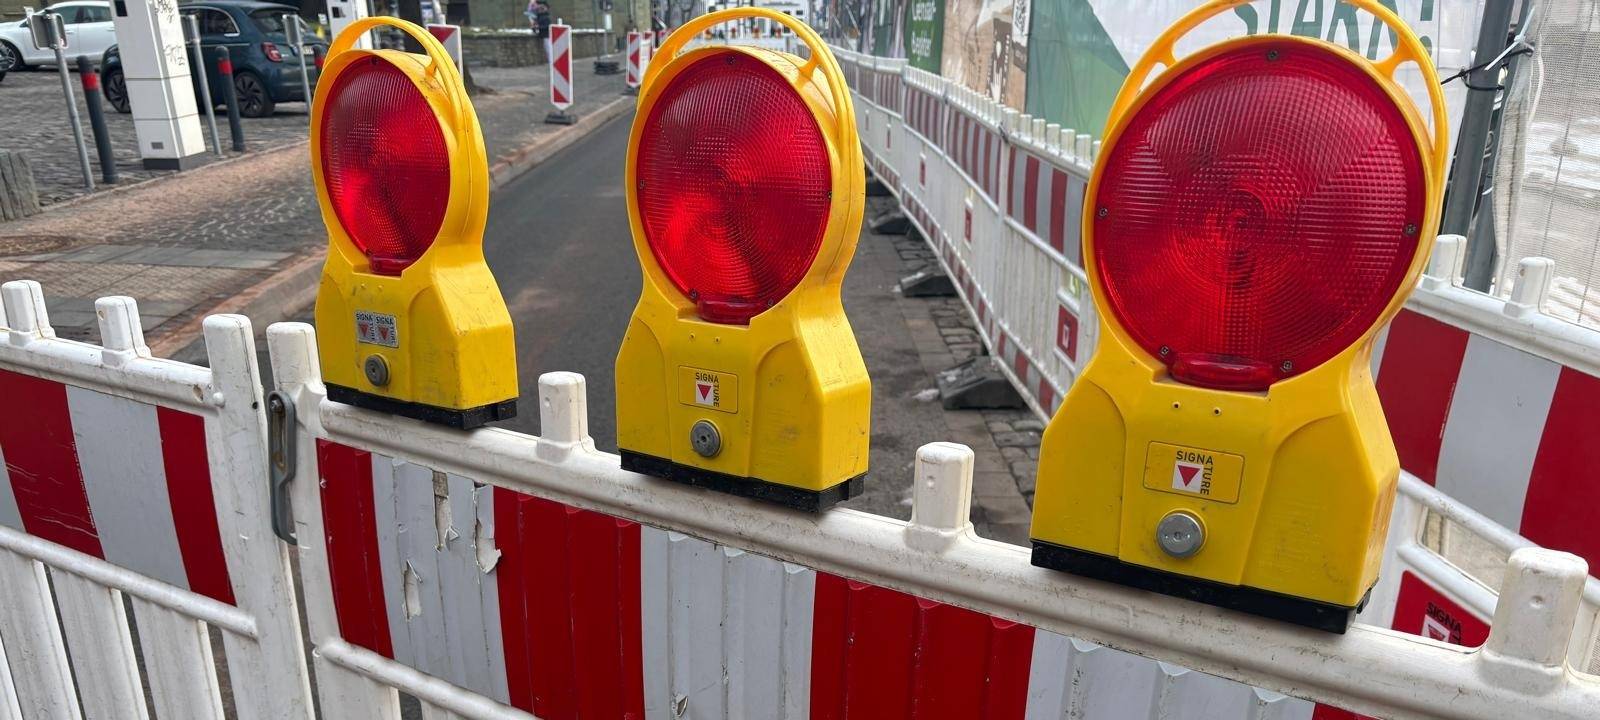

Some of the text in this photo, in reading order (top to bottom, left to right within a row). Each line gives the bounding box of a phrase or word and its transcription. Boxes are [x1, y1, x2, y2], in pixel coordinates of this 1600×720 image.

[695, 372, 719, 383] SIGNA
[1176, 450, 1214, 466] SIGNA
[1200, 466, 1214, 496] TURE
[1426, 601, 1461, 632] SIGNA
